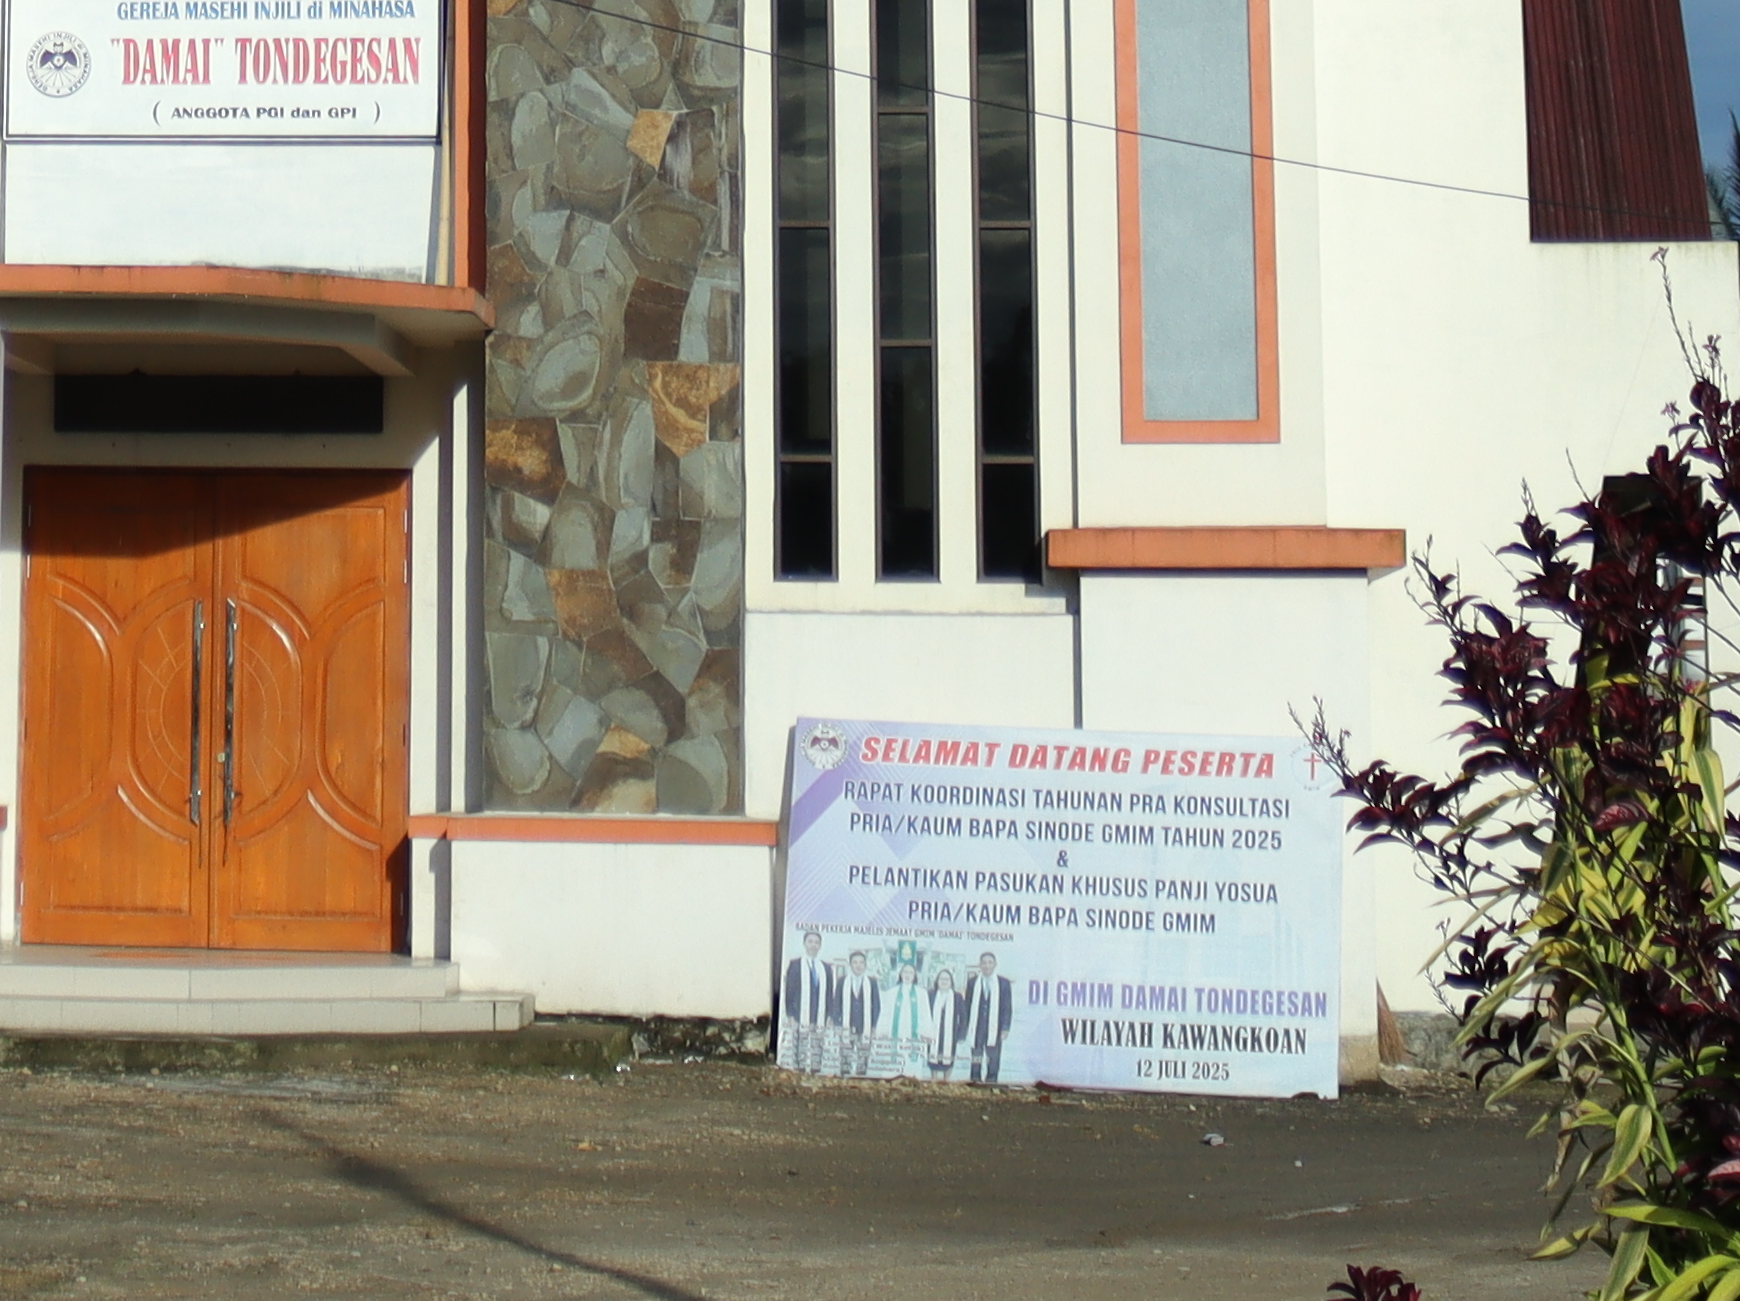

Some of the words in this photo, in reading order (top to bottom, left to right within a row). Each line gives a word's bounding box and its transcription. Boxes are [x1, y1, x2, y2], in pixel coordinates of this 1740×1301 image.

[117, 1, 180, 21] GEREJA
[185, 0, 248, 21] MASEHI
[254, 0, 302, 21] INJILI
[307, 0, 323, 20] di
[328, 0, 416, 19] MINAHASA
[234, 37, 422, 85] TONDEGESAN
[256, 107, 285, 120] PGI
[290, 107, 321, 120] dan
[860, 736, 1001, 767] SELAMAT
[1008, 743, 1132, 774] DATANG
[1140, 749, 1275, 778] PESERTA
[844, 781, 904, 802] RAPAT
[910, 783, 1026, 807] KOORDINASI
[1033, 789, 1122, 812] TAHUNAN
[1129, 793, 1167, 815] PRA
[1173, 795, 1290, 819] KONSULTASI
[850, 812, 962, 837] PRIA/KAUM
[969, 818, 1019, 839] BAPA
[1025, 820, 1095, 842] SINODE
[1102, 824, 1154, 845] GMIM
[1161, 826, 1225, 848] TAHUN
[1232, 829, 1283, 850] 2025
[1056, 849, 1069, 868] &
[848, 864, 968, 890] PELANTIKAN
[975, 870, 1065, 894] PASUKAN
[1071, 875, 1148, 898] KHUSUS
[1155, 879, 1208, 901] PANJI
[1215, 881, 1279, 904] YOSUA
[908, 900, 1022, 925] PRIA/KAUM
[1028, 905, 1079, 928] BAPA
[1085, 908, 1155, 931] SINODE
[1162, 912, 1217, 934] GMIM
[967, 931, 1014, 942] TONDEGESAN
[1028, 979, 1048, 1006] DI
[1056, 981, 1114, 1009] GMIM
[1120, 983, 1187, 1013] DAMAI
[1194, 987, 1327, 1018] TONDEGESAN
[1060, 1017, 1155, 1048] WILAYAH
[1161, 1022, 1307, 1055] KAWANGKOAN
[1136, 1059, 1153, 1078] 12
[1157, 1059, 1187, 1080] JULI
[1191, 1061, 1230, 1082] 2025
